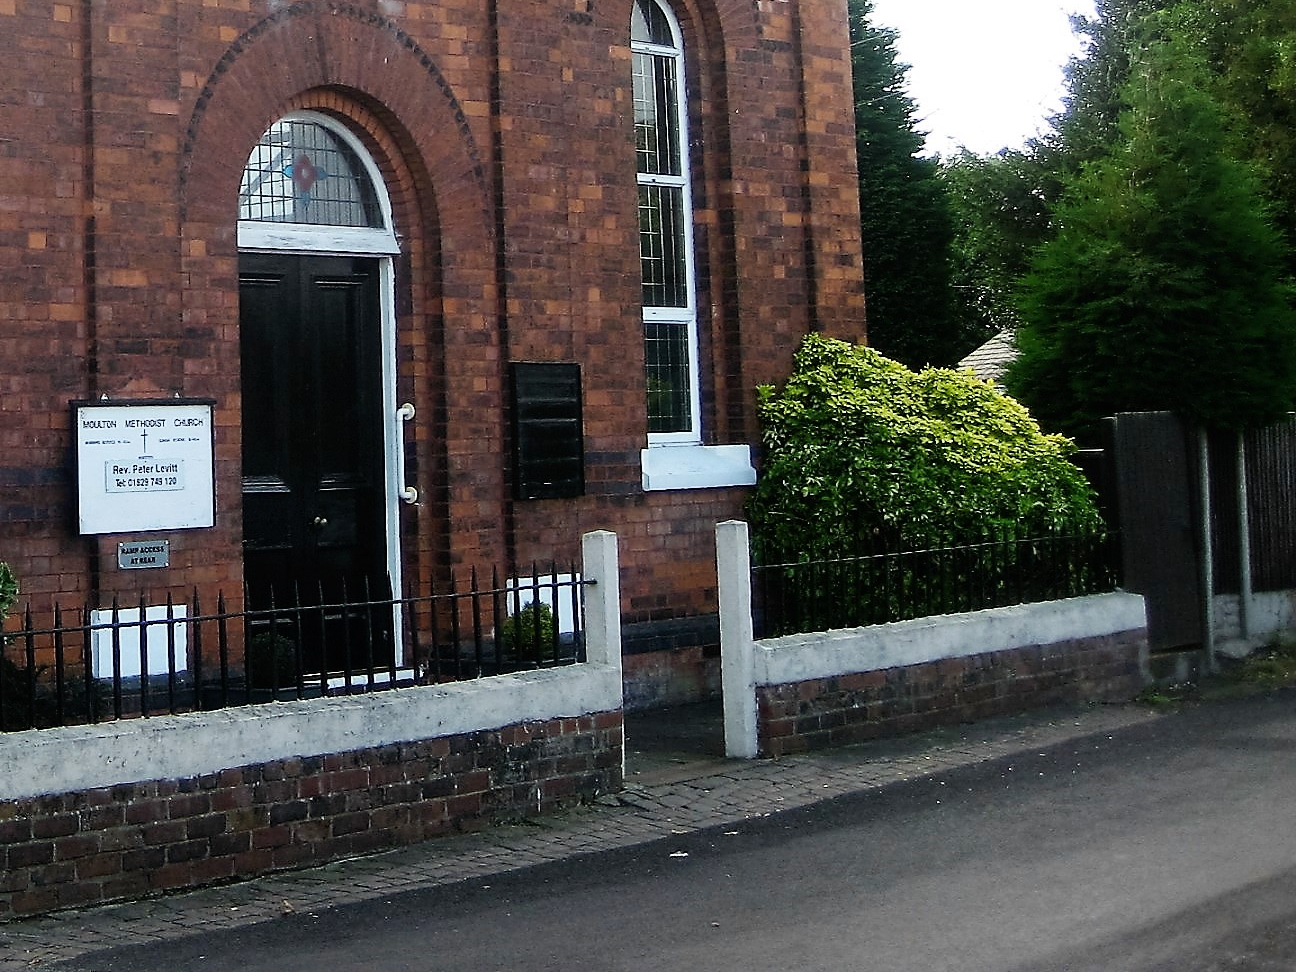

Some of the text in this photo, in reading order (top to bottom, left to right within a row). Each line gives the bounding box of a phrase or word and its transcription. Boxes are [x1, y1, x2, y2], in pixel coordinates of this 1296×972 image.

[83, 417, 204, 429] MOULTON METHODIST CHURCH
[112, 465, 131, 475] Rev.
[132, 464, 154, 474] Peter
